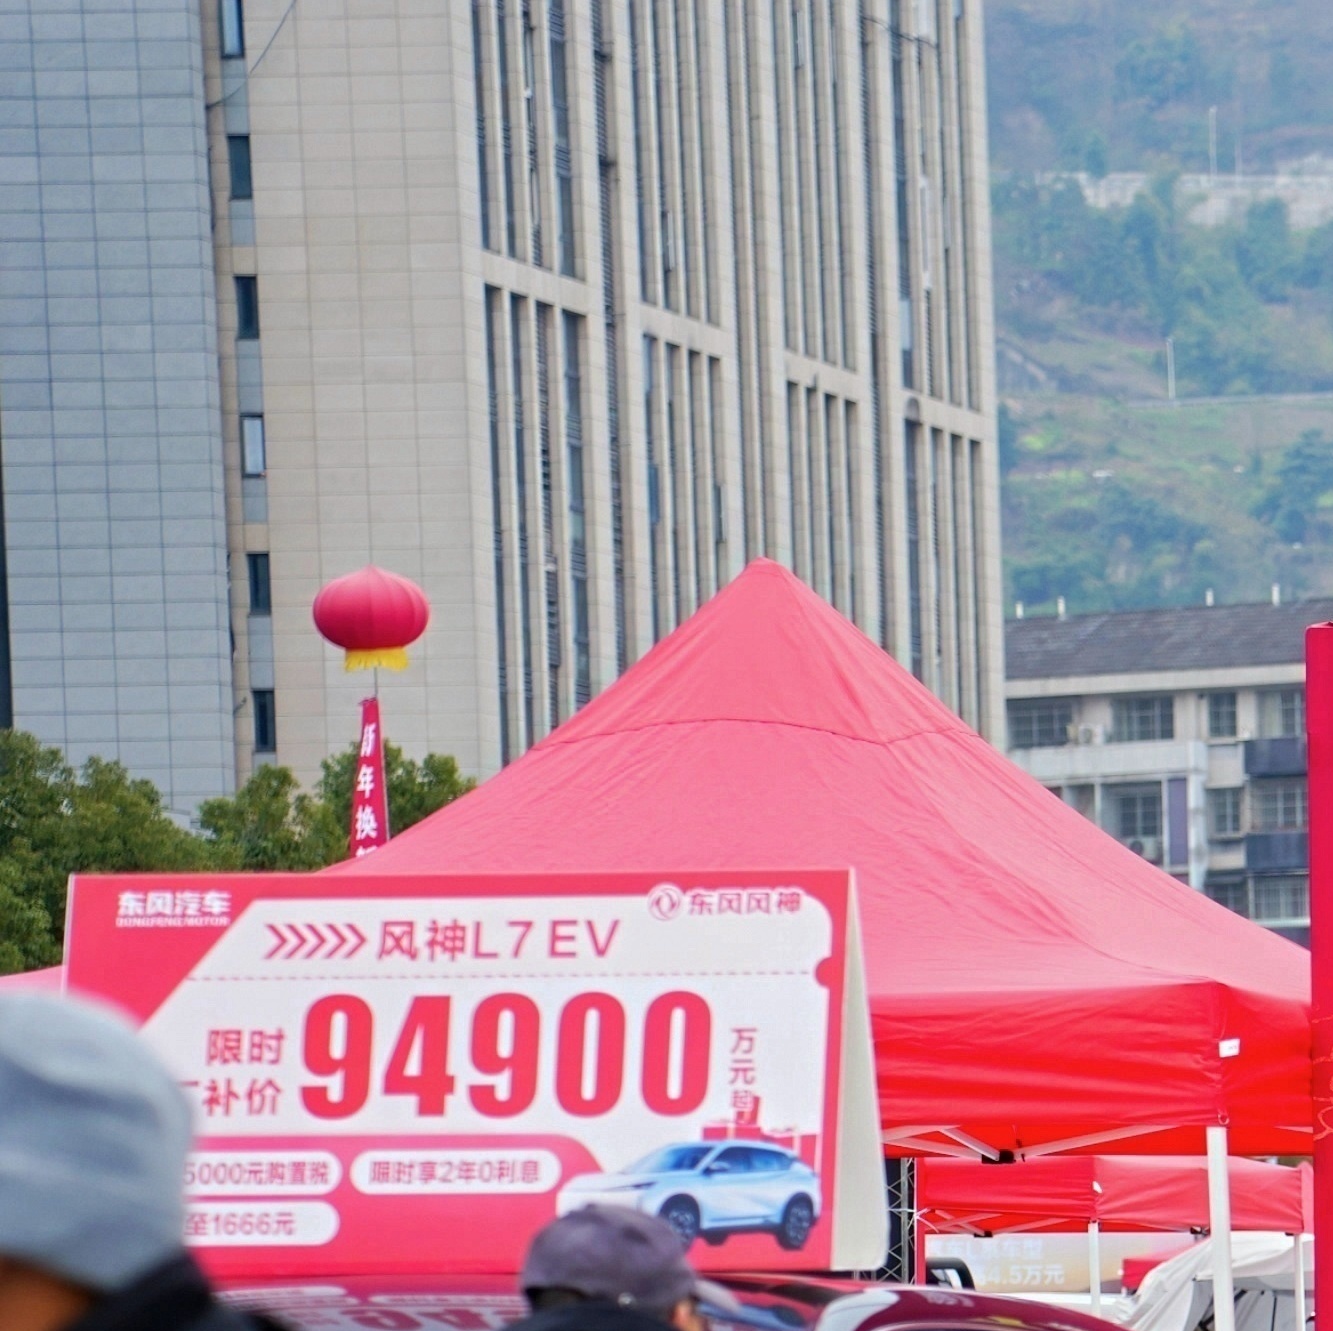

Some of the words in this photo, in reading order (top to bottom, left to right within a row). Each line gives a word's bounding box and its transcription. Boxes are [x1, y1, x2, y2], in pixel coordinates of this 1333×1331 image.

[118, 889, 231, 916] 东风汽车
[688, 891, 802, 916] 东风风神
[207, 1028, 285, 1065] 限时
[300, 990, 712, 1120] 94900
[178, 1078, 283, 1117] 补价
[369, 1159, 541, 1185] 限时享2年0利息
